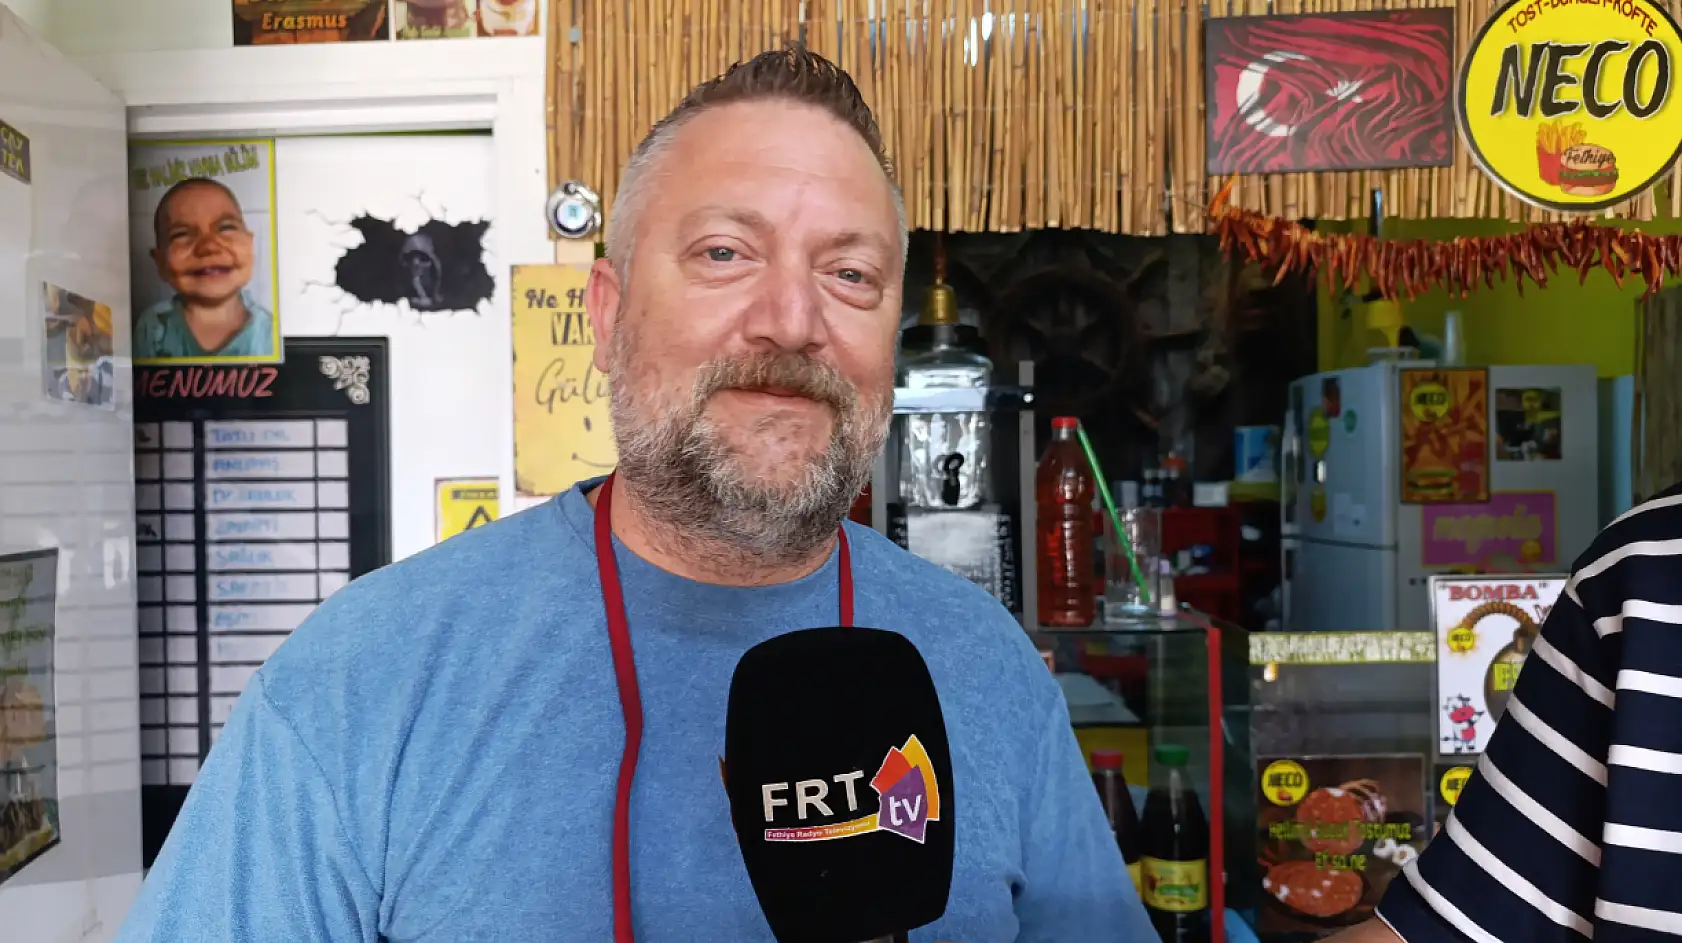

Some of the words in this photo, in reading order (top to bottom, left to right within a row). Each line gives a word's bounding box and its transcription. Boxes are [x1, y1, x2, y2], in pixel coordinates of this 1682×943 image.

[262, 12, 347, 30] Erasmus
[1507, 0, 1658, 37] TOST-B-KÖFTE
[1490, 39, 1671, 120] NECO
[1565, 149, 1614, 168] Fethiye
[525, 288, 558, 309] Ne
[565, 288, 586, 308] H
[761, 769, 865, 823] FRT
[889, 794, 922, 827] tv
[768, 831, 796, 840] Fethiye
[797, 831, 823, 839] Radyo
